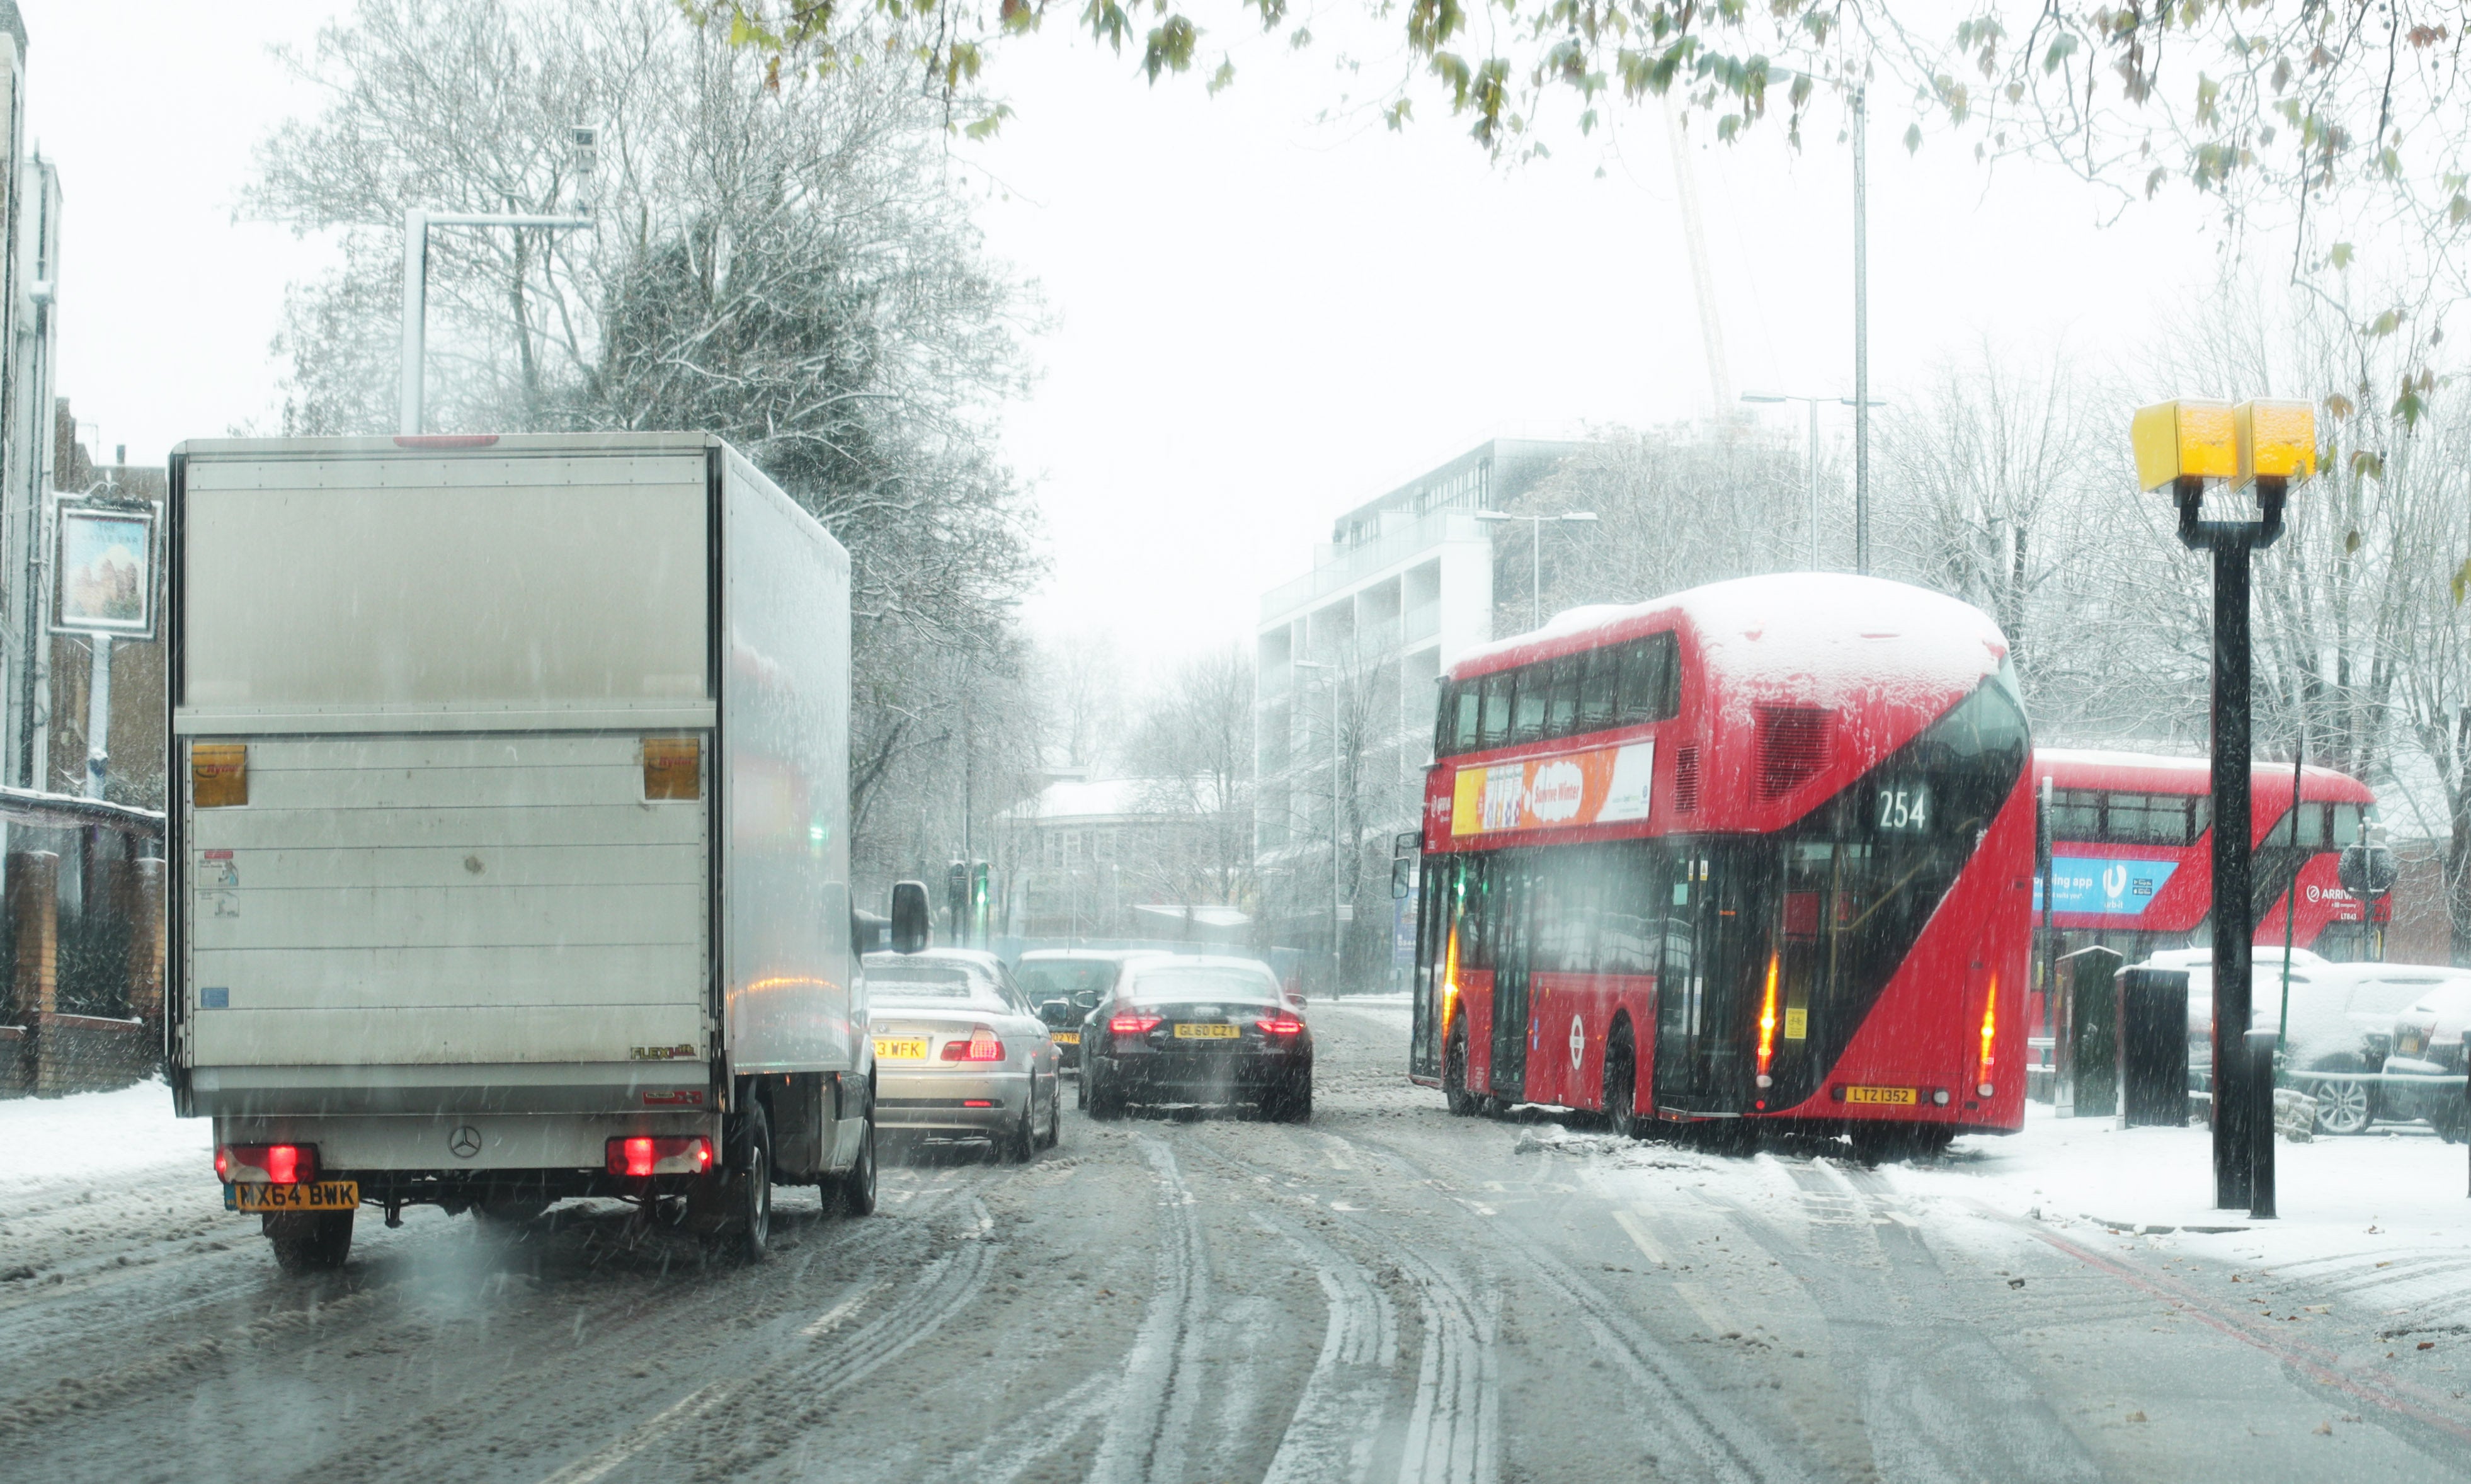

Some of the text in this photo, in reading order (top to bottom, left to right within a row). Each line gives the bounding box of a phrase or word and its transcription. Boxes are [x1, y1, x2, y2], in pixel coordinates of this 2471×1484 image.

[1534, 780, 1580, 804] Survive Winter
[1880, 790, 1926, 829] 254
[2073, 878, 2092, 889] app
[2321, 888, 2356, 900] ARRIV
[1180, 1025, 1210, 1036] GL60
[891, 1042, 920, 1057] WFK
[240, 1184, 302, 1206] MX64
[309, 1184, 355, 1206] BWK
